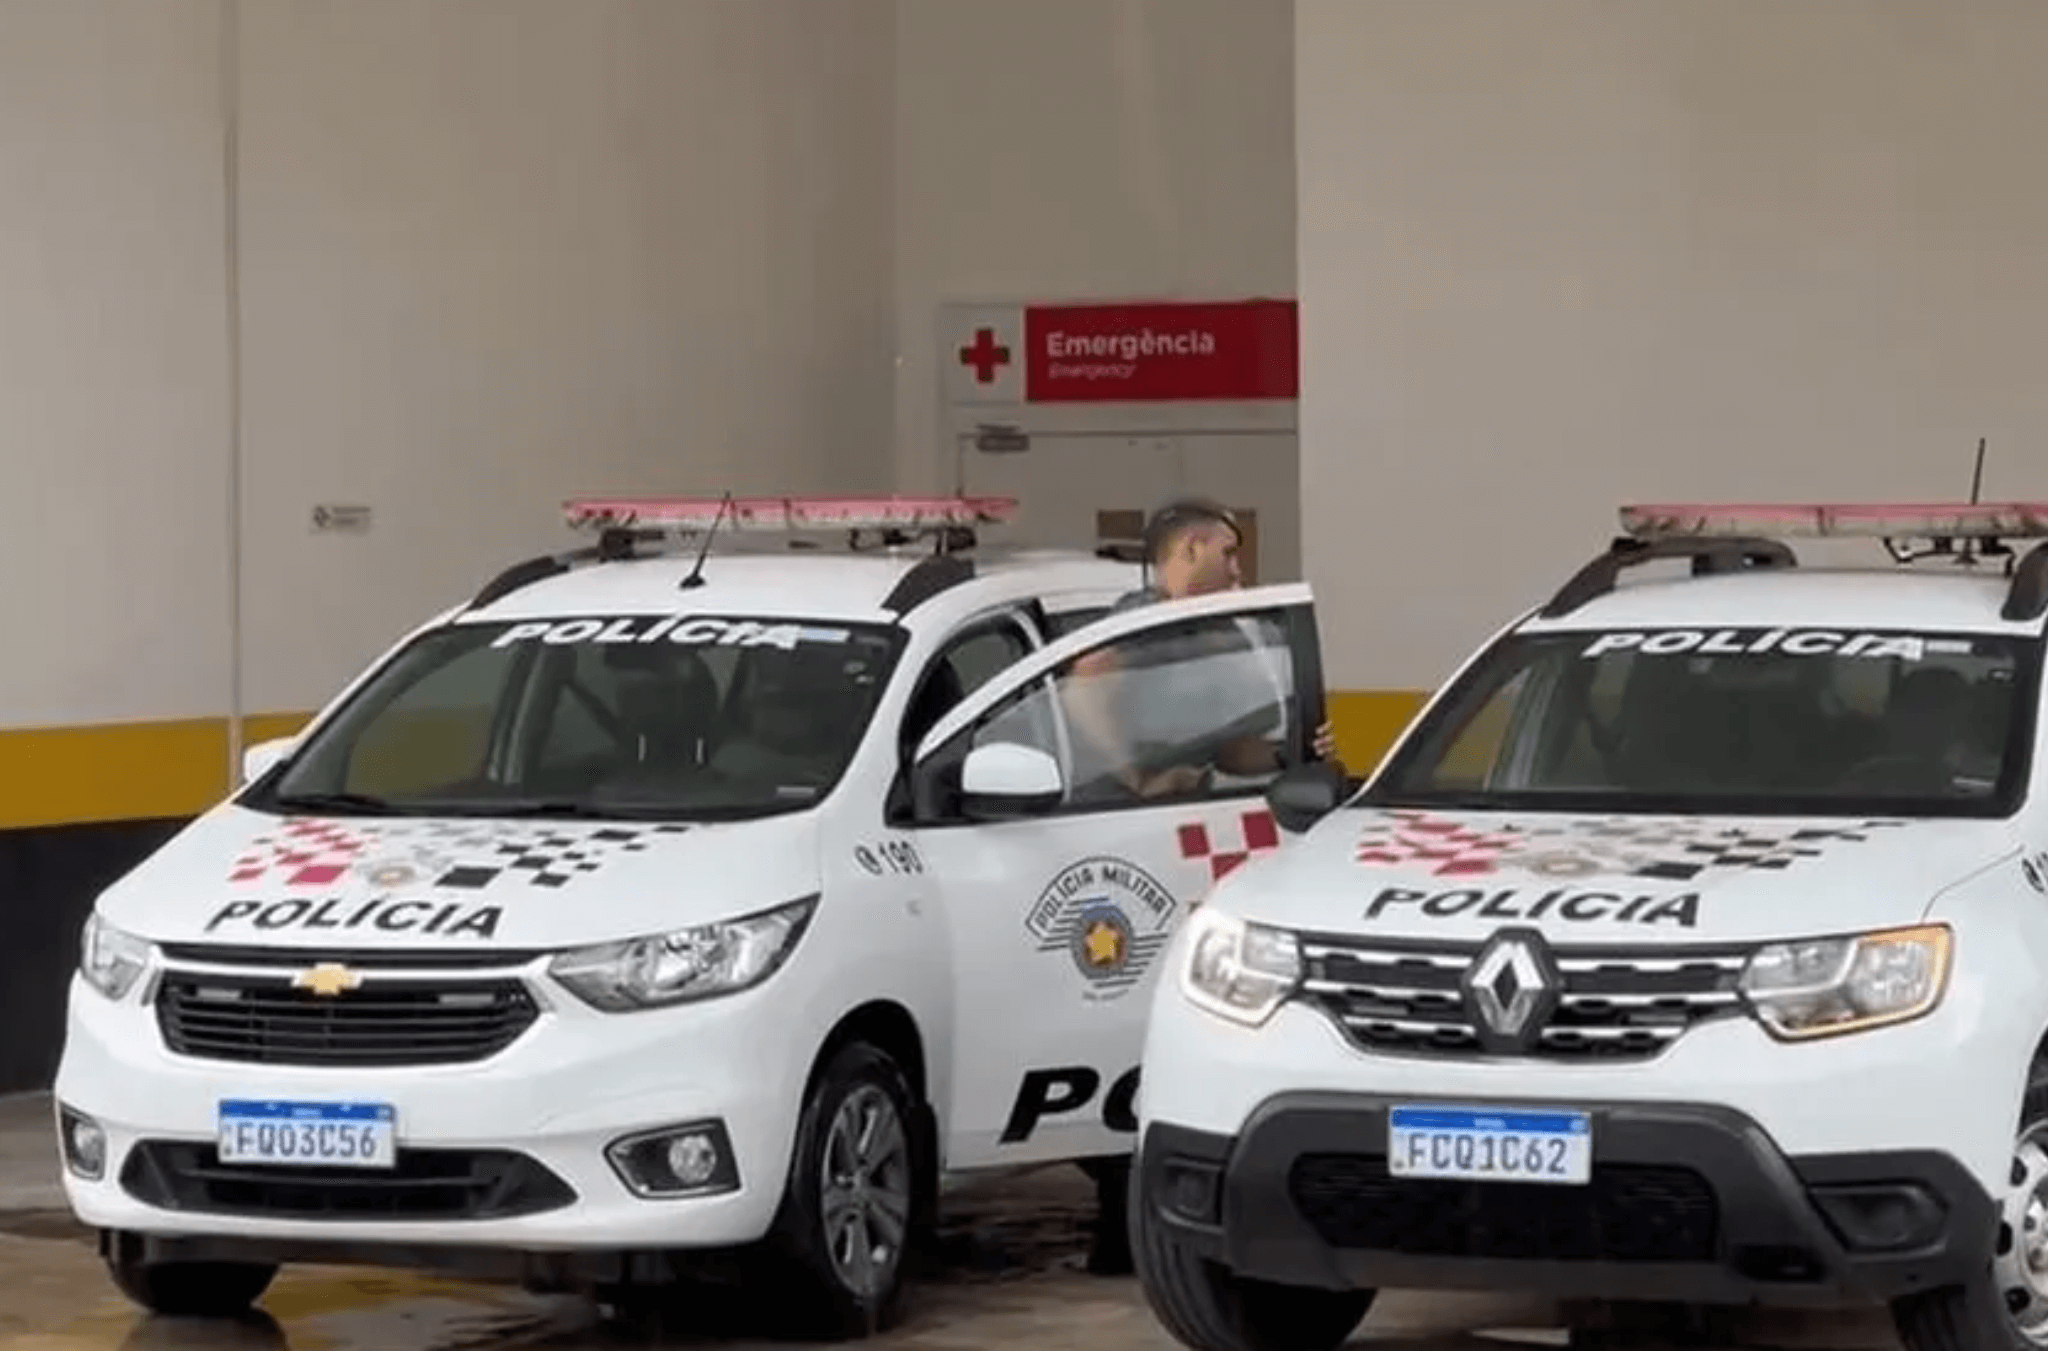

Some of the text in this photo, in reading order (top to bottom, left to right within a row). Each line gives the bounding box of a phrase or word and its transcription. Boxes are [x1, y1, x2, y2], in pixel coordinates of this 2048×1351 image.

[1046, 327, 1216, 360] Emergência
[1102, 865, 1167, 914] MILITAR
[1408, 1132, 1567, 1174] FCQ1C62
